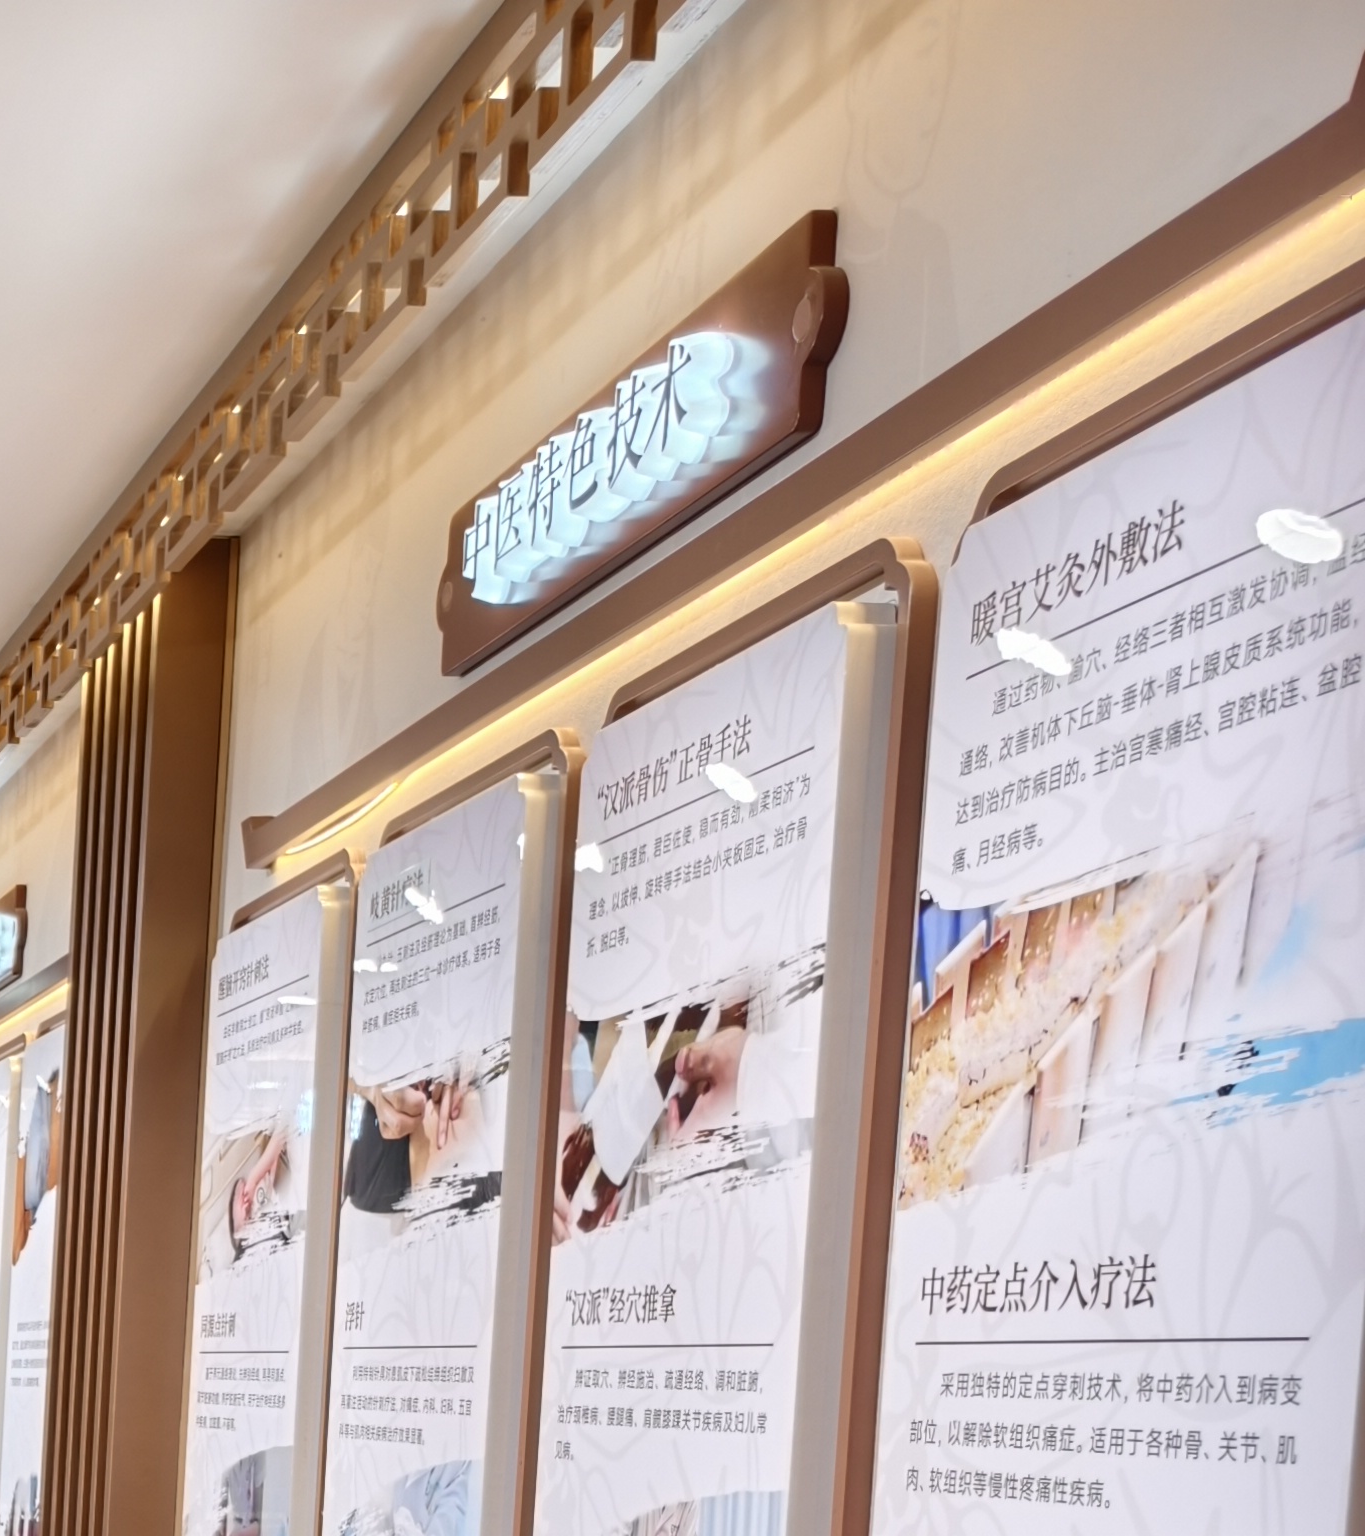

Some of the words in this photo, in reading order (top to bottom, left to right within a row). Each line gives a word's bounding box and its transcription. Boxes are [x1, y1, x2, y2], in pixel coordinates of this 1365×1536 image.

[463, 340, 701, 585] 中医特色技术
[970, 500, 1185, 647] 暖宫艾灸外敷法
[565, 1284, 677, 1326] “汉派”经穴推拿
[921, 1253, 1157, 1316] 中药定点介入疗法
[940, 1371, 1302, 1406] 采用独特的定点穿刺技术，将中药介入到病变
[910, 1419, 1297, 1466] 部位，以解除软组织痛症。适用于各种骨、关节、肌
[905, 1466, 1111, 1509] 肉、软组织等慢性疼痛性疾病。
